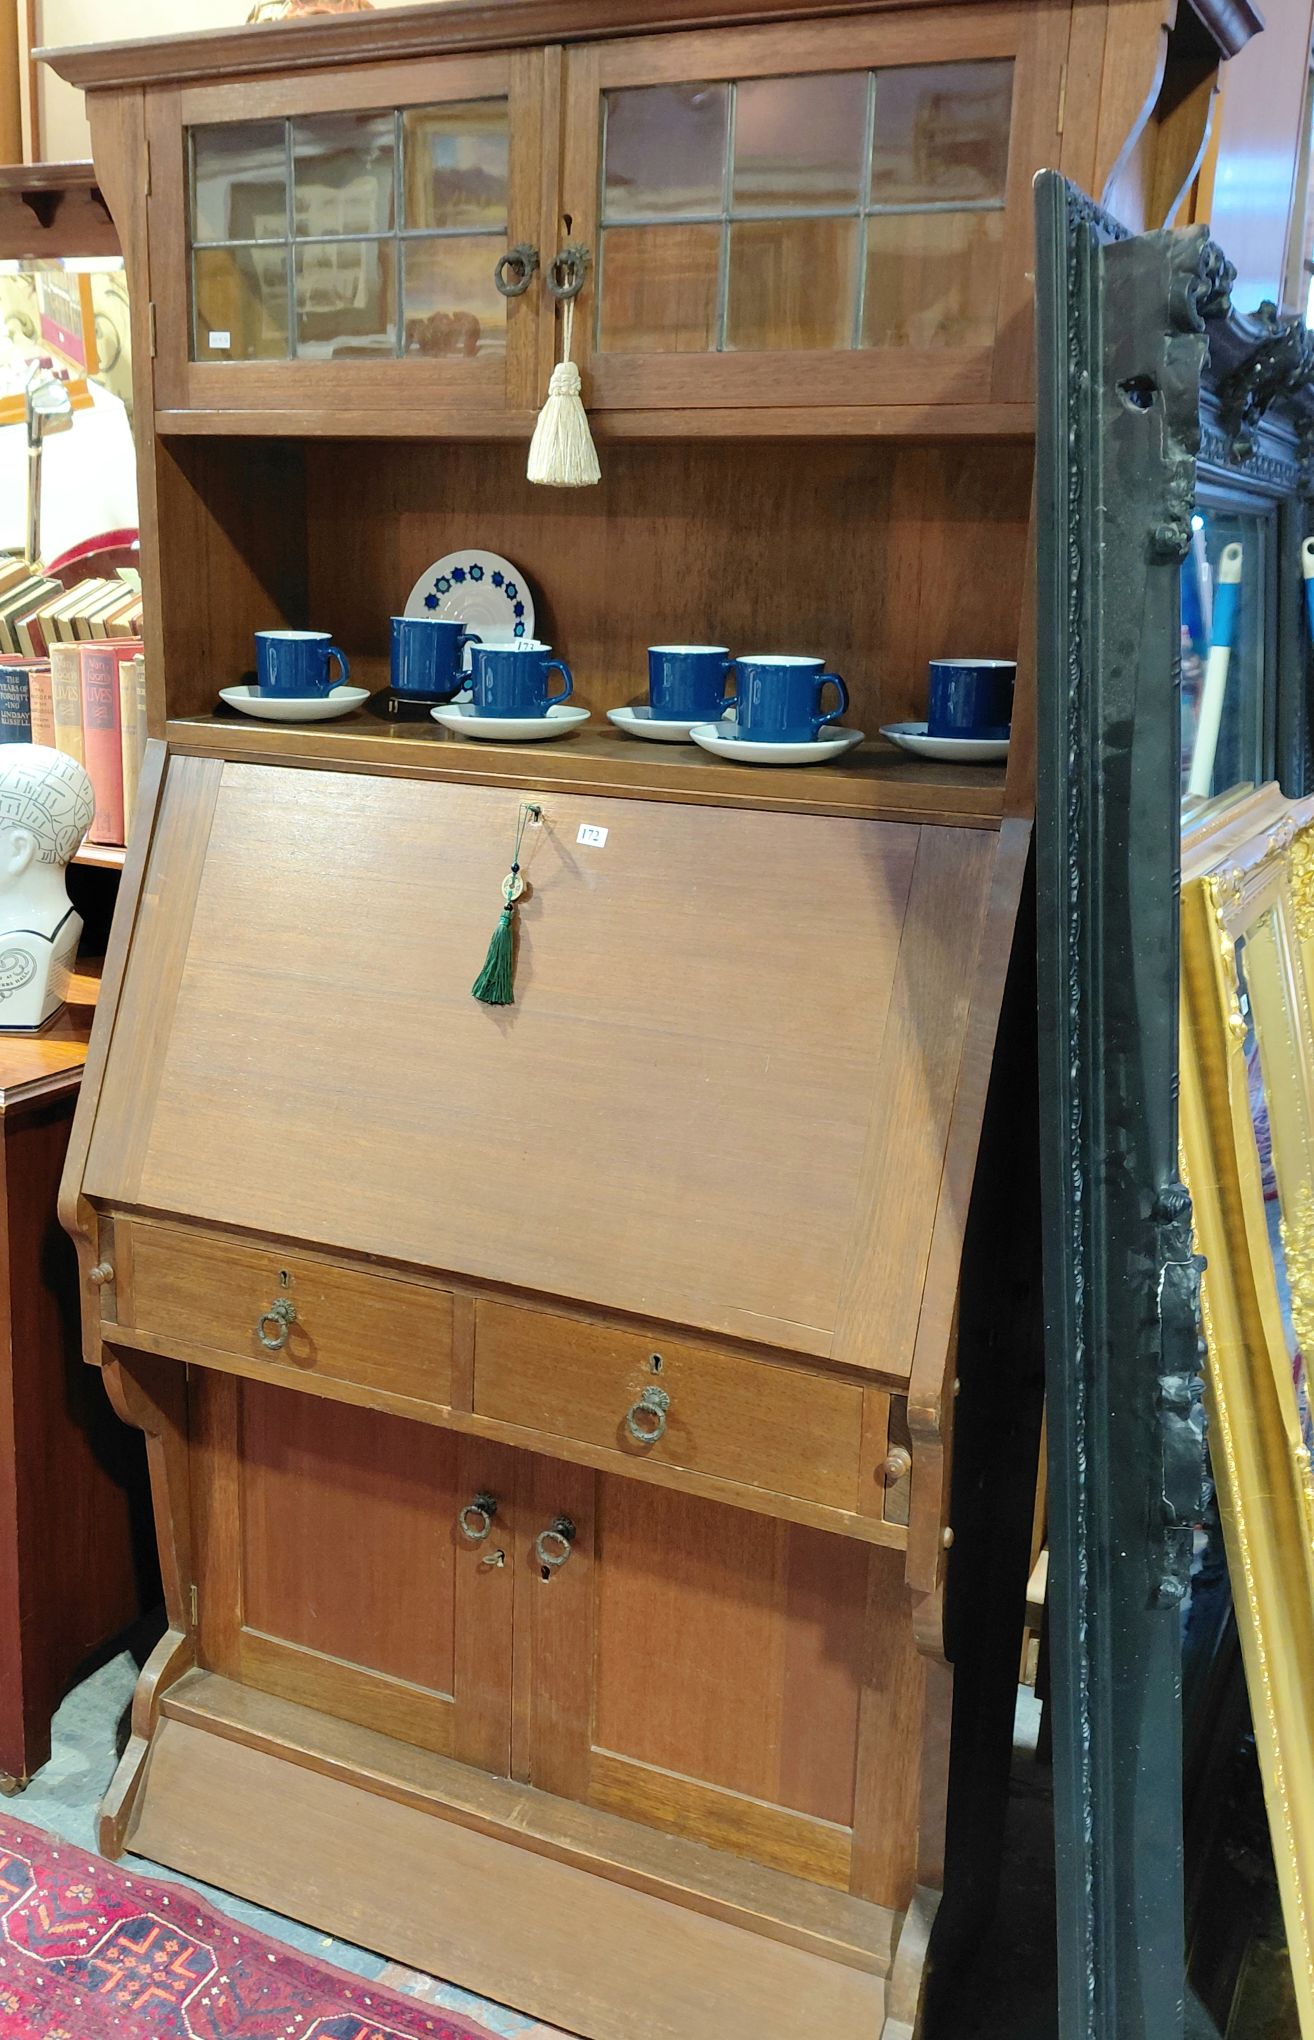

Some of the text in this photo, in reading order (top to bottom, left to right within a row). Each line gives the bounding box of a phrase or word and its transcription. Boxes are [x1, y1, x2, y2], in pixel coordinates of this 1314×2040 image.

[6, 675, 20, 684] THE
[88, 687, 113, 703] LIVES
[1, 710, 31, 719] LINDSAY
[1, 718, 31, 727] RUSSELL
[582, 828, 600, 842] 172
